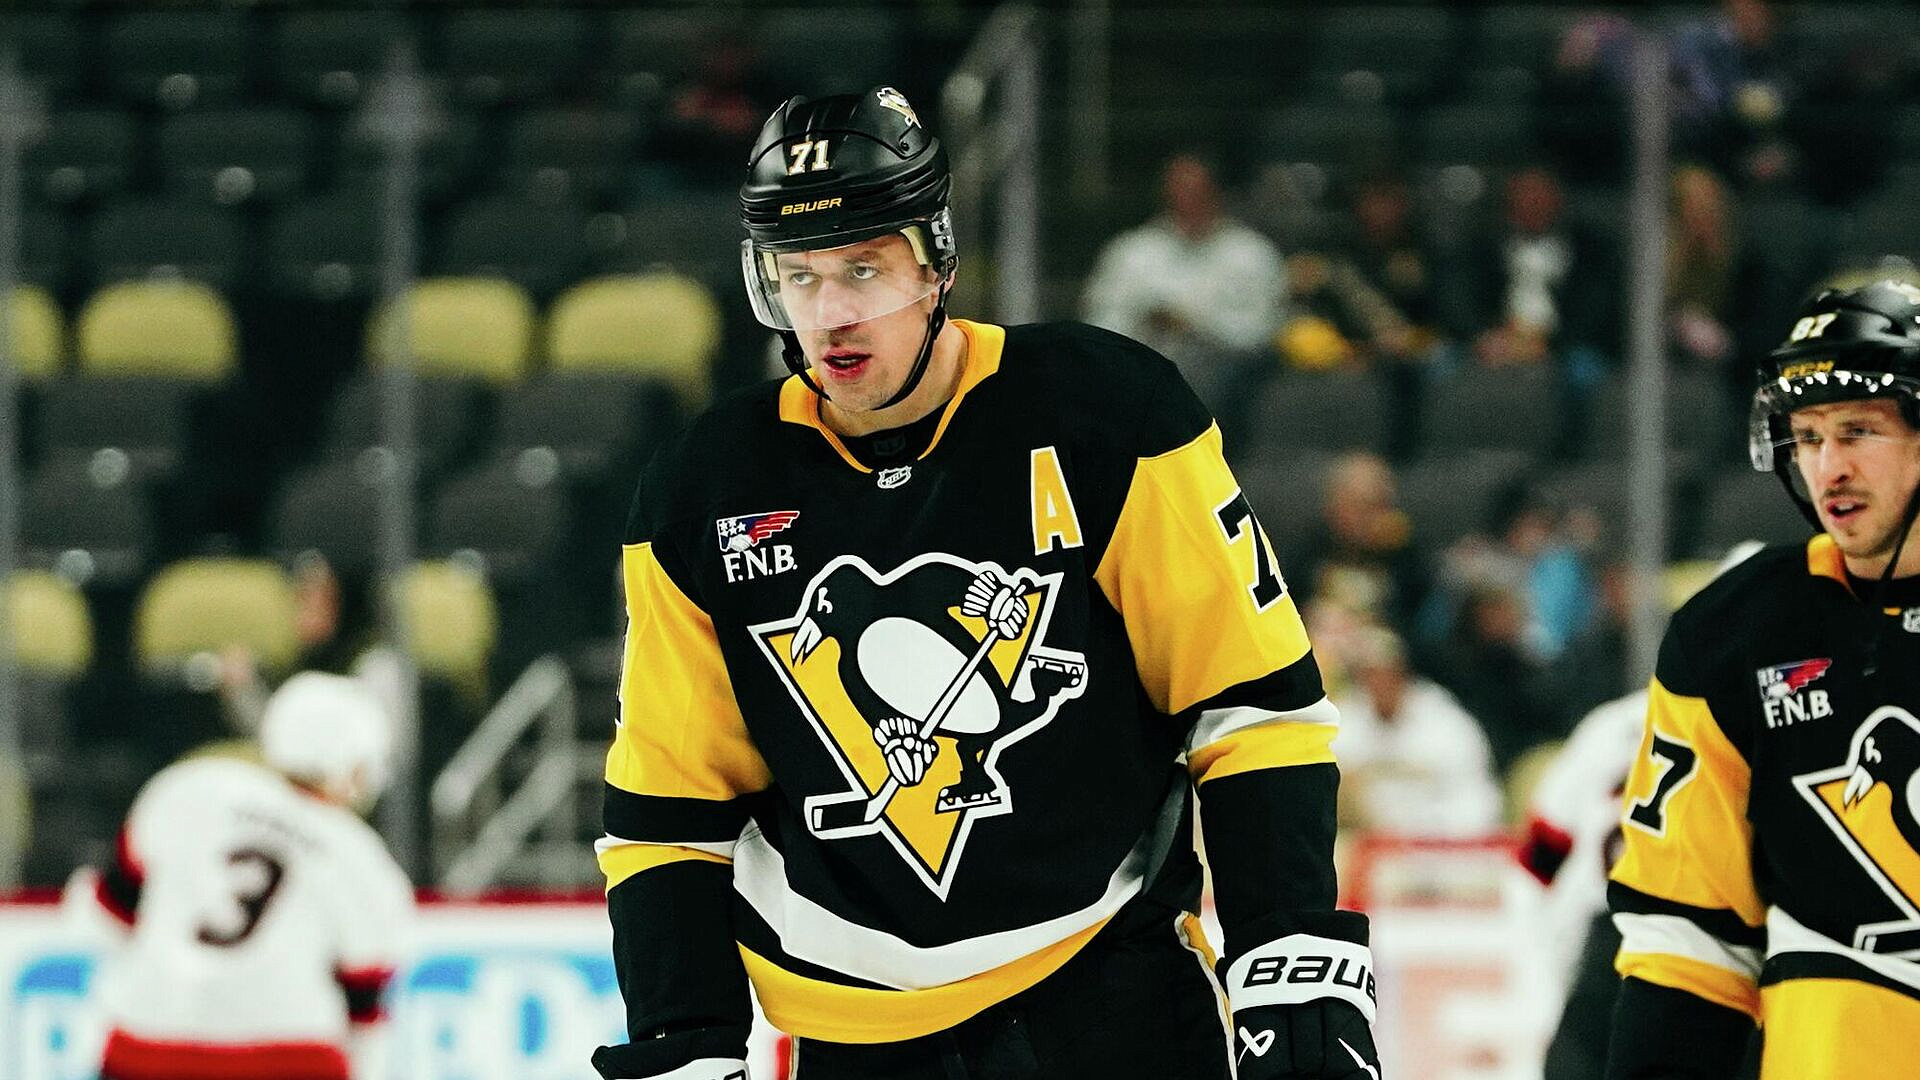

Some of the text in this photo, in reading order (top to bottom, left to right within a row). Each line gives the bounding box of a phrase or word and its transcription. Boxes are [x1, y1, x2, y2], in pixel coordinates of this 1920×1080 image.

[789, 140, 829, 176] 71
[781, 197, 842, 215] BAUER
[1031, 446, 1084, 555] A
[722, 544, 798, 583] F.N.B.
[1763, 689, 1833, 729] F.N.B.
[196, 849, 284, 947] 3
